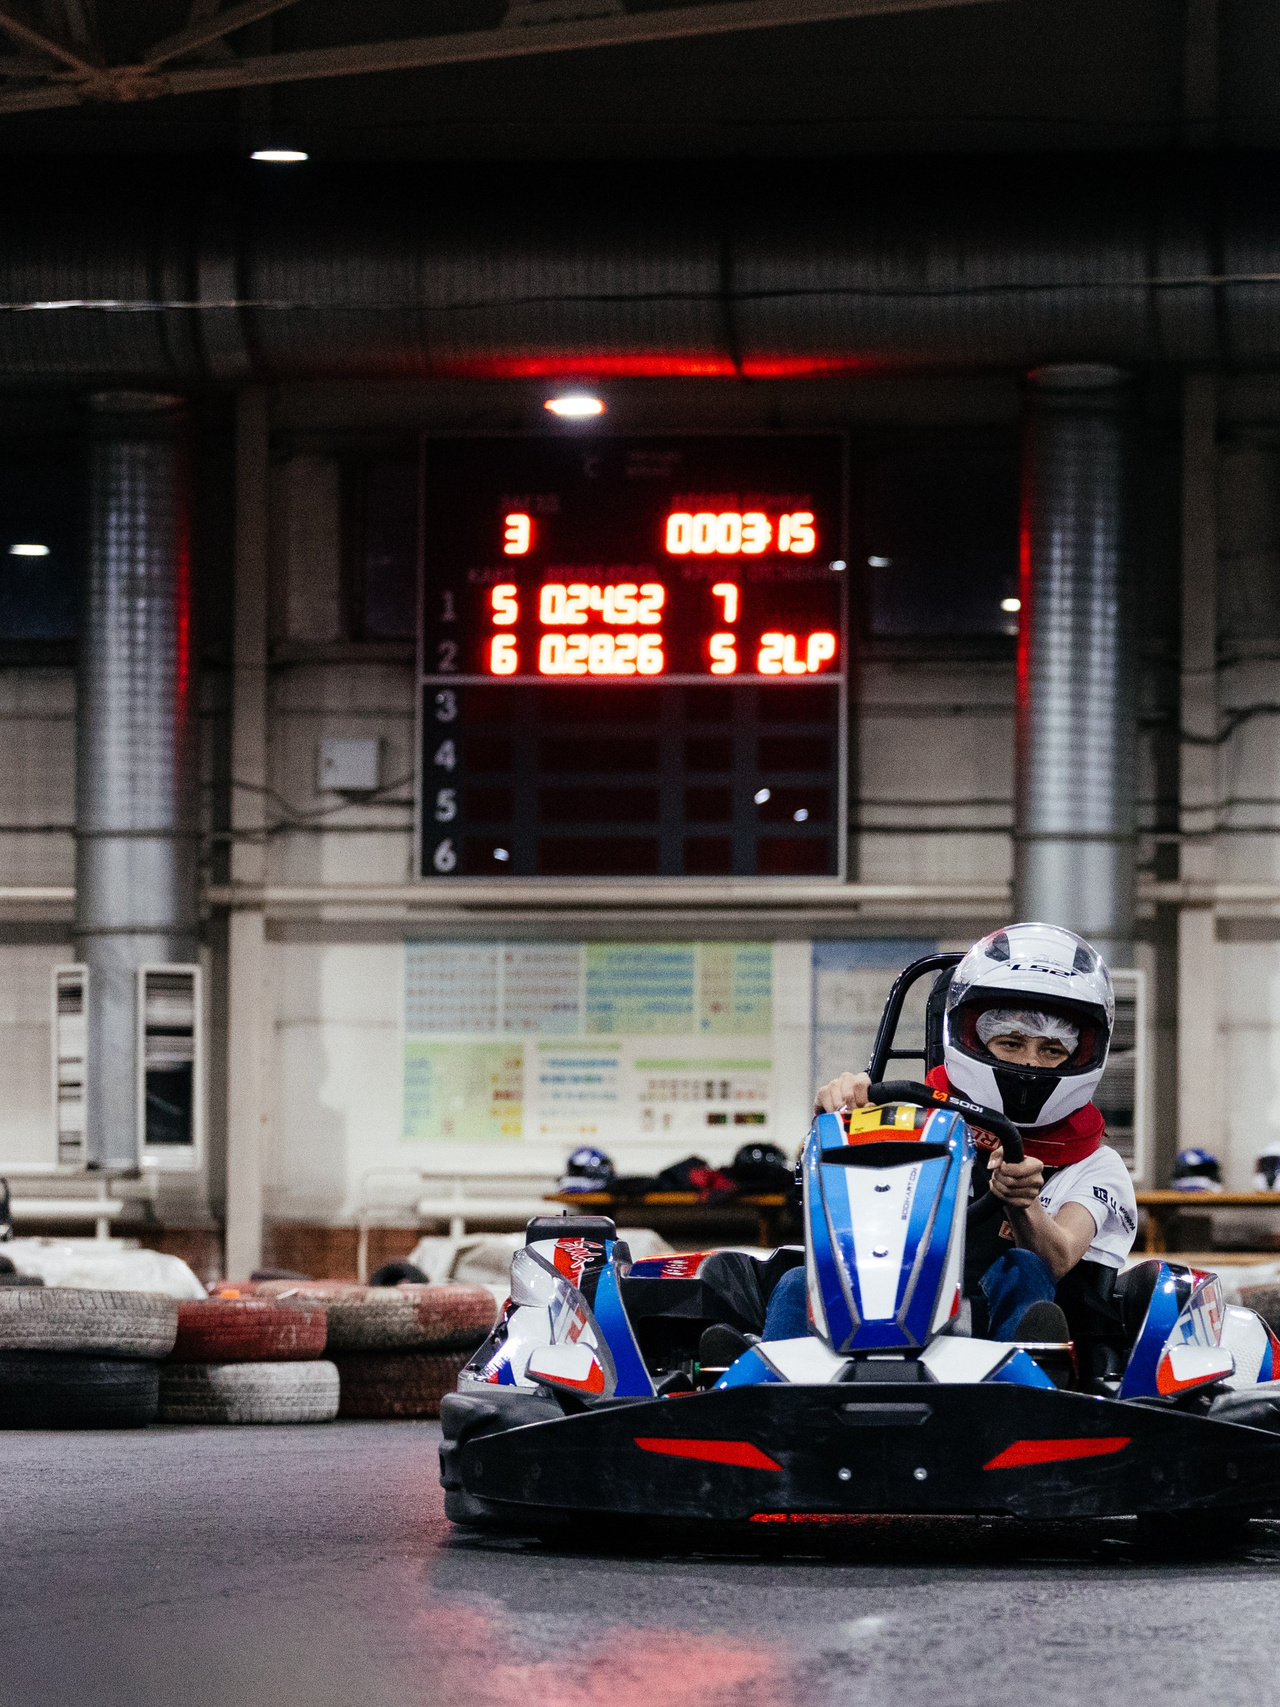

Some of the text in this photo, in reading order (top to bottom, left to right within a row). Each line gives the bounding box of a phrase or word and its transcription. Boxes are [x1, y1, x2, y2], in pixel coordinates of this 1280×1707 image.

[504, 513, 531, 554] 3
[442, 590, 456, 622] 1
[712, 583, 738, 623] 7
[438, 640, 460, 671] 2
[490, 633, 518, 674] 6
[434, 690, 458, 722] 3
[434, 740, 458, 771] 4
[435, 789, 457, 822] 5
[433, 838, 457, 872] 6
[1011, 964, 1071, 980] LS2
[949, 1096, 983, 1113] SODI
